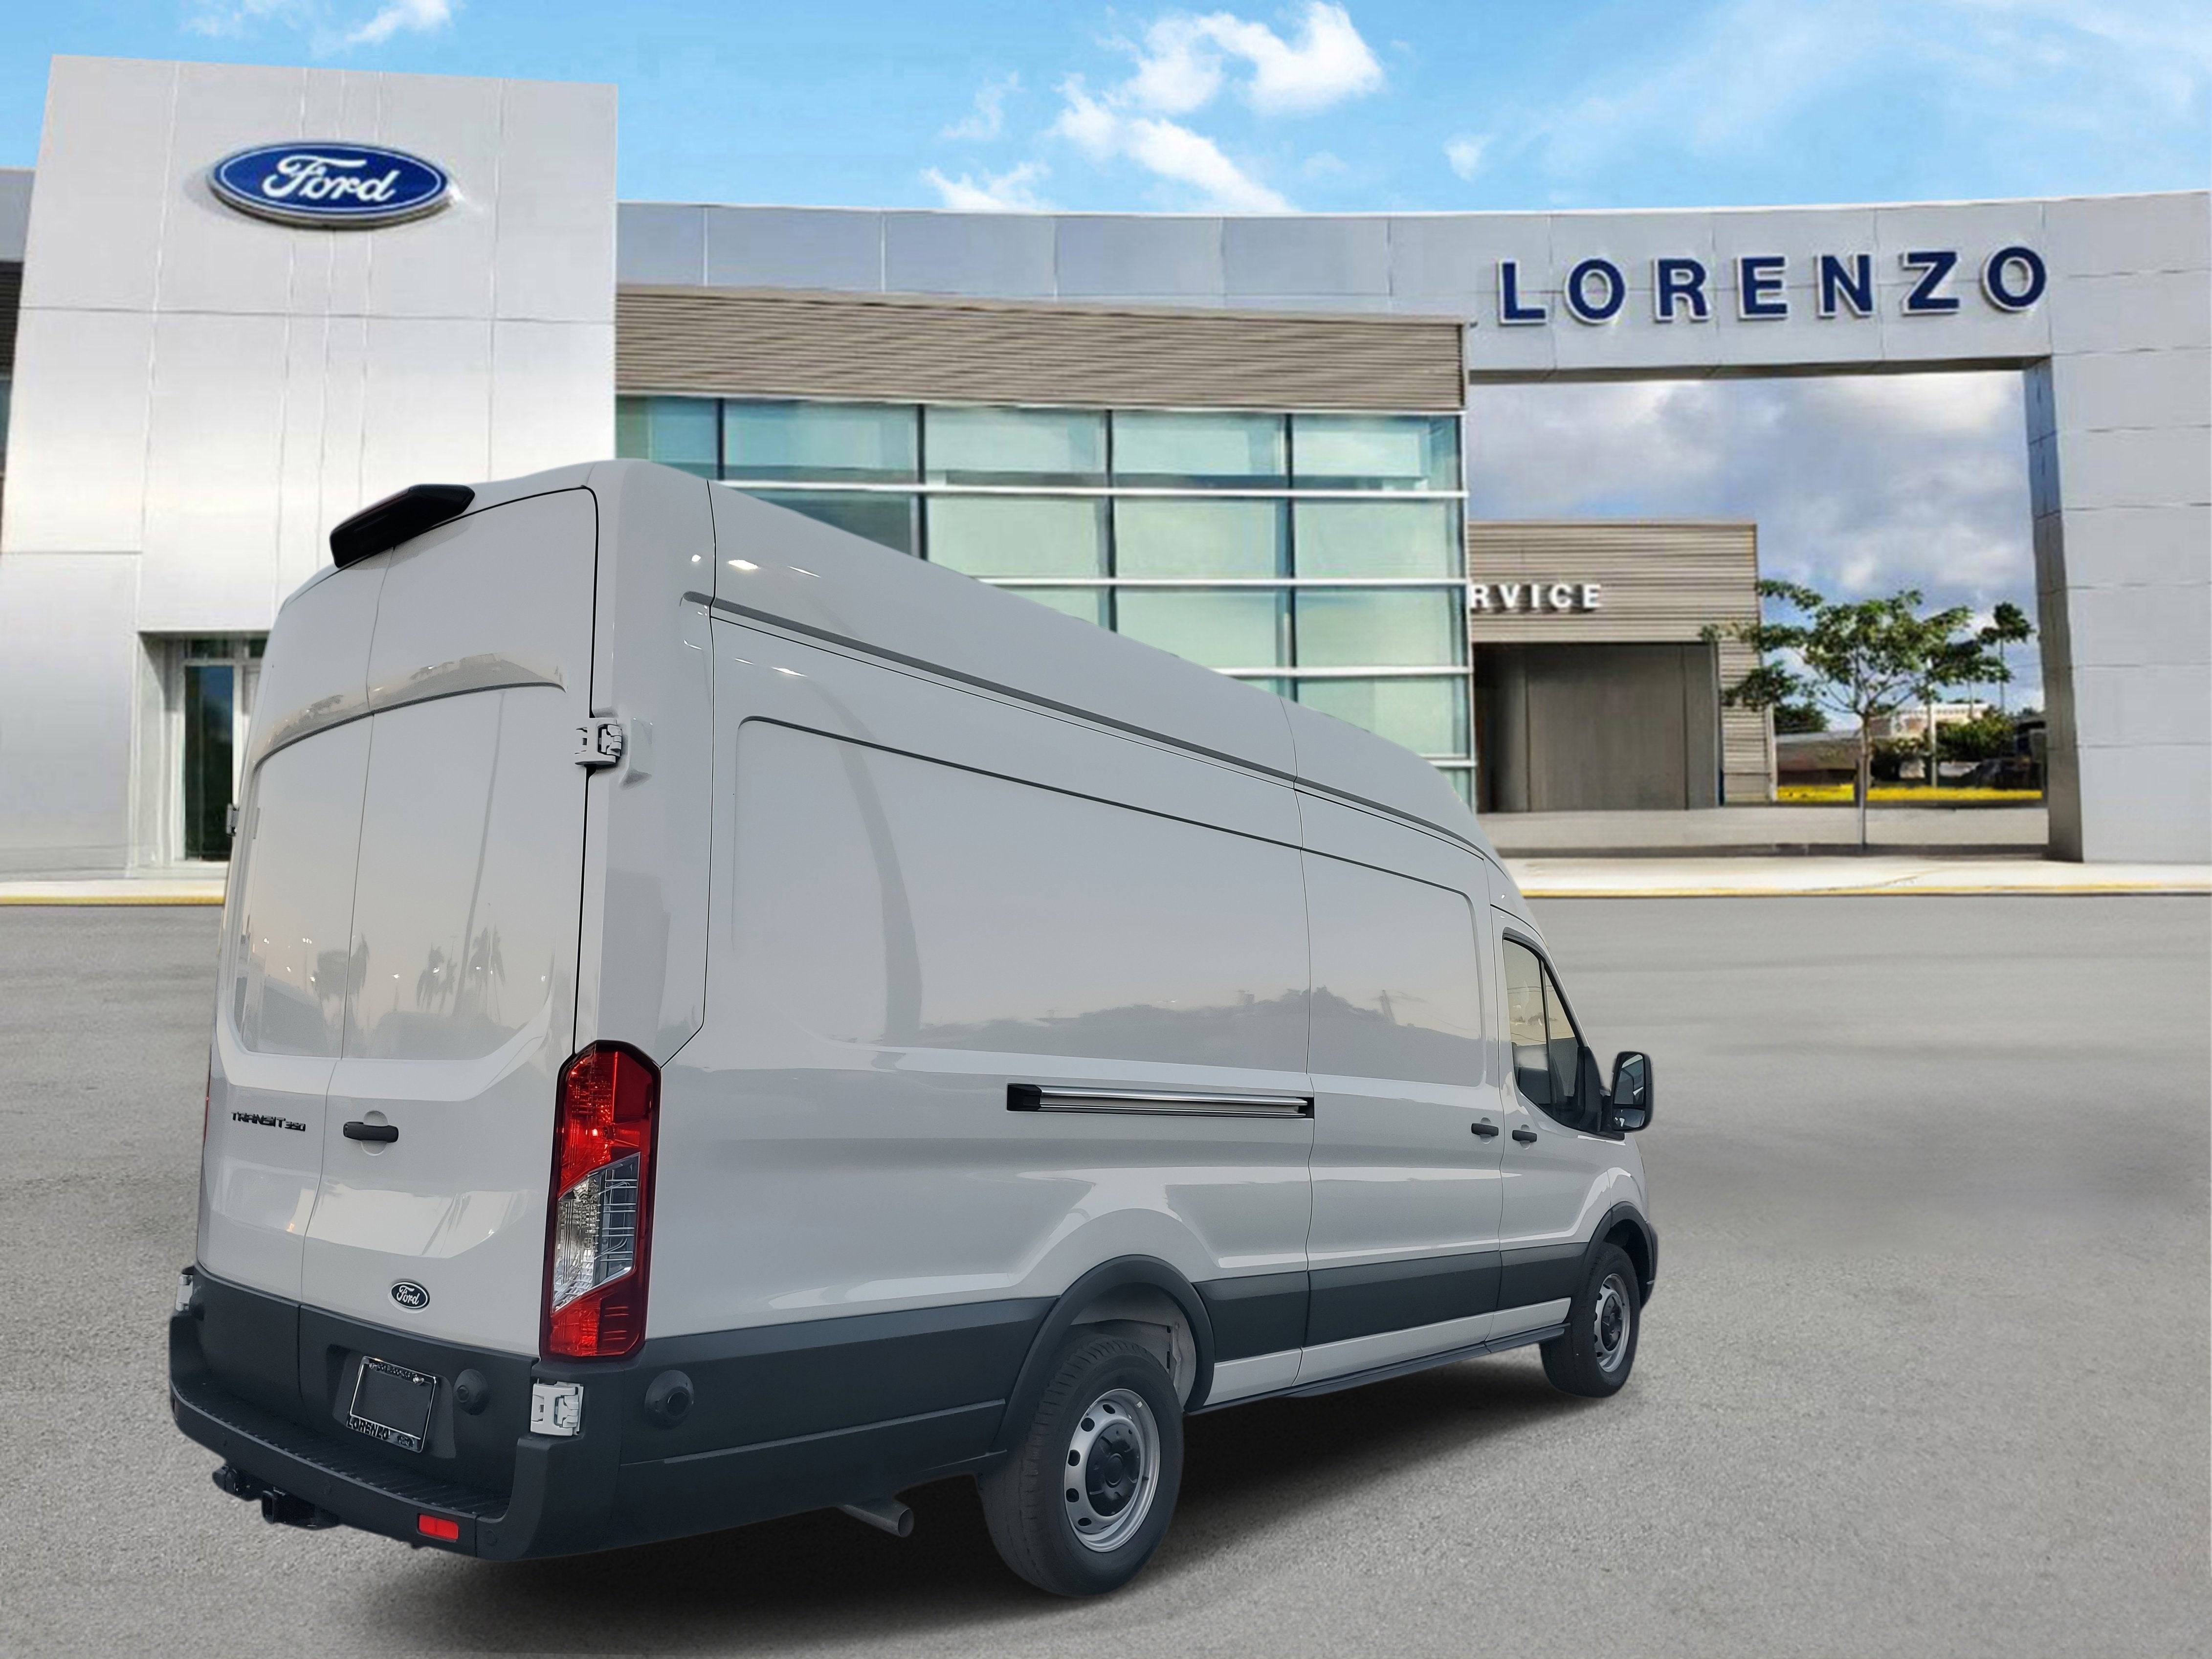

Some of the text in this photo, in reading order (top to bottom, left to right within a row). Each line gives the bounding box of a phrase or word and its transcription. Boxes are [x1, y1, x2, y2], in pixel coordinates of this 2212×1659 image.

[263, 155, 400, 201] Ford
[1498, 245, 2047, 323] LORENZO
[231, 1111, 286, 1128] TRANSIT
[396, 1285, 420, 1305] Ford
